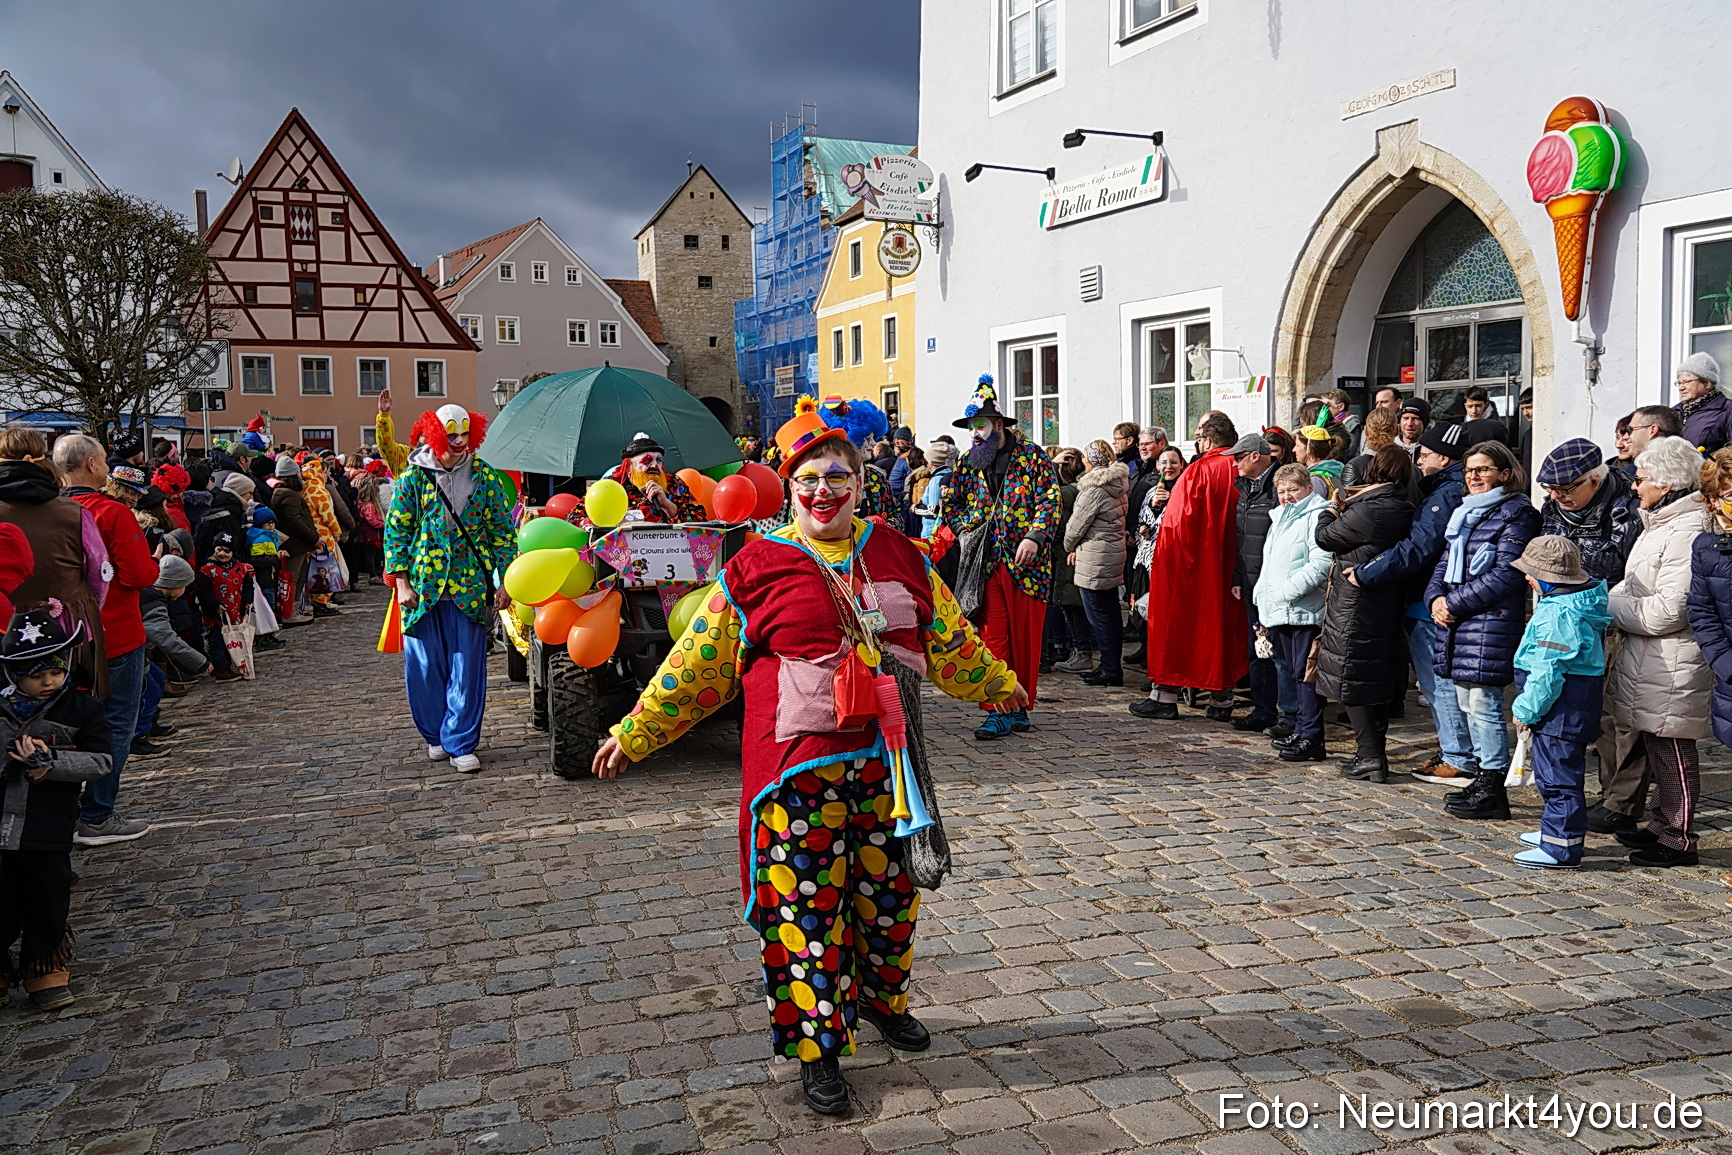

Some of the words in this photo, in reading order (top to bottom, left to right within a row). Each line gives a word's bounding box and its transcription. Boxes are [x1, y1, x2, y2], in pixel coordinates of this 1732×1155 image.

[880, 156, 917, 169] Pizzeria
[889, 170, 909, 181] Café
[1062, 180, 1086, 194] Pizzeria
[1112, 165, 1138, 179] Eisdiele
[879, 181, 918, 195] Eisdiele
[886, 203, 912, 212] Bella
[1057, 193, 1092, 219] Bella
[1096, 185, 1138, 208] Roma
[868, 208, 897, 216] Roma
[631, 532, 678, 541] Kunterbunt
[639, 547, 665, 555] Clowns
[664, 563, 676, 580] 3
